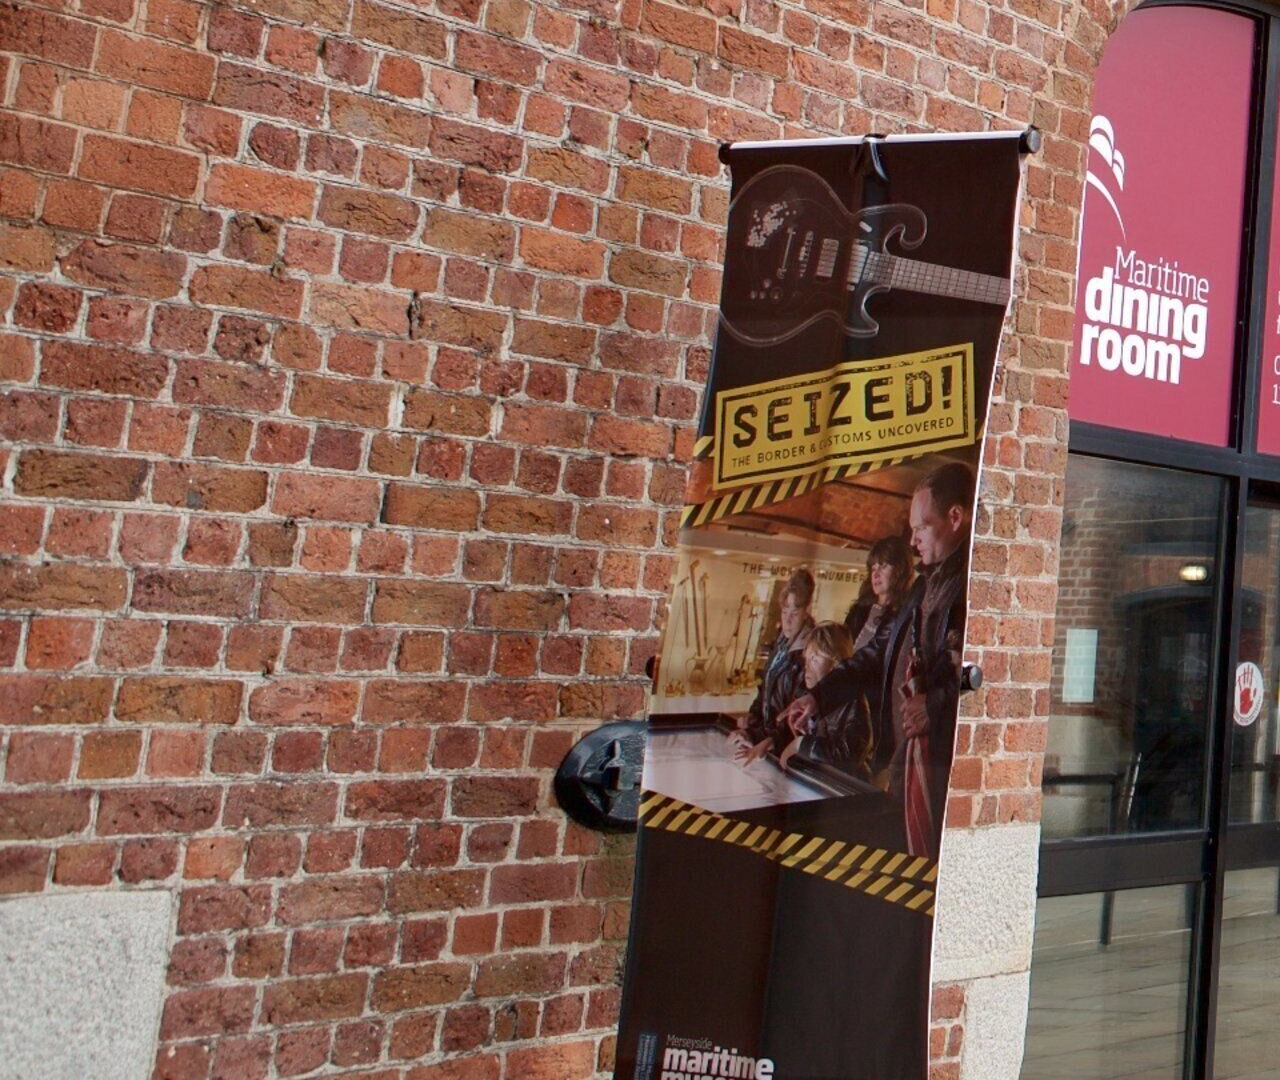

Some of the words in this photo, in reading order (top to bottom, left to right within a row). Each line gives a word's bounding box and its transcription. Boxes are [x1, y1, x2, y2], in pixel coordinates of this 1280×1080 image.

[1114, 245, 1209, 304] Maritime
[1084, 266, 1209, 360] dining
[1079, 323, 1181, 385] room
[733, 365, 953, 449] SEIZED!
[732, 454, 751, 468] THE
[757, 445, 805, 464] BORDER
[810, 441, 816, 453] &
[819, 432, 872, 451] CUSTOMS
[878, 416, 954, 439] UNCOVERED
[742, 562, 762, 575] THE
[663, 1046, 775, 1080] maritime
[666, 1034, 713, 1049] Merseyside
